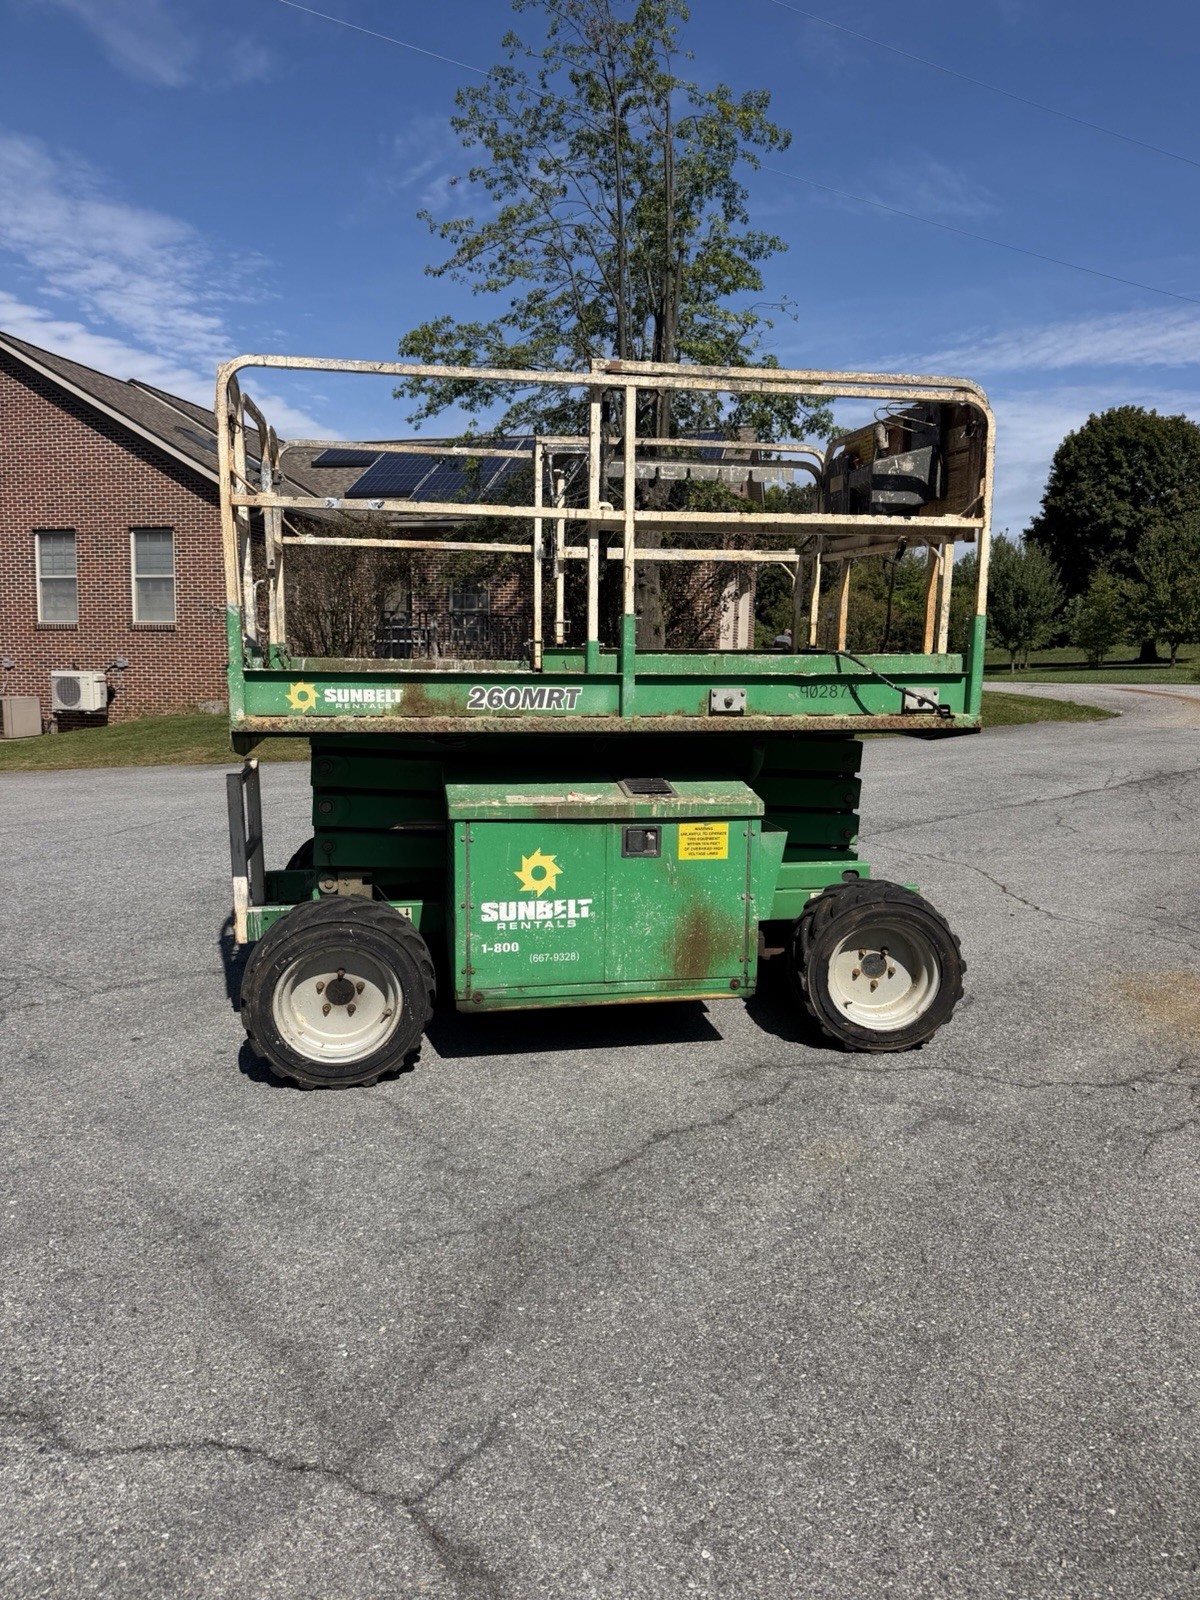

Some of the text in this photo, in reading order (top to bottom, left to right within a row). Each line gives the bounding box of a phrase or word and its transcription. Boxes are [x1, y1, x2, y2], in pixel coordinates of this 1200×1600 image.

[323, 687, 404, 703] SUNBELT
[466, 685, 584, 711] 260MRT
[480, 898, 593, 923] SUNBELT
[496, 919, 577, 931] RENTALS
[480, 941, 520, 954] 1-800
[529, 950, 580, 964] (667-9328)
